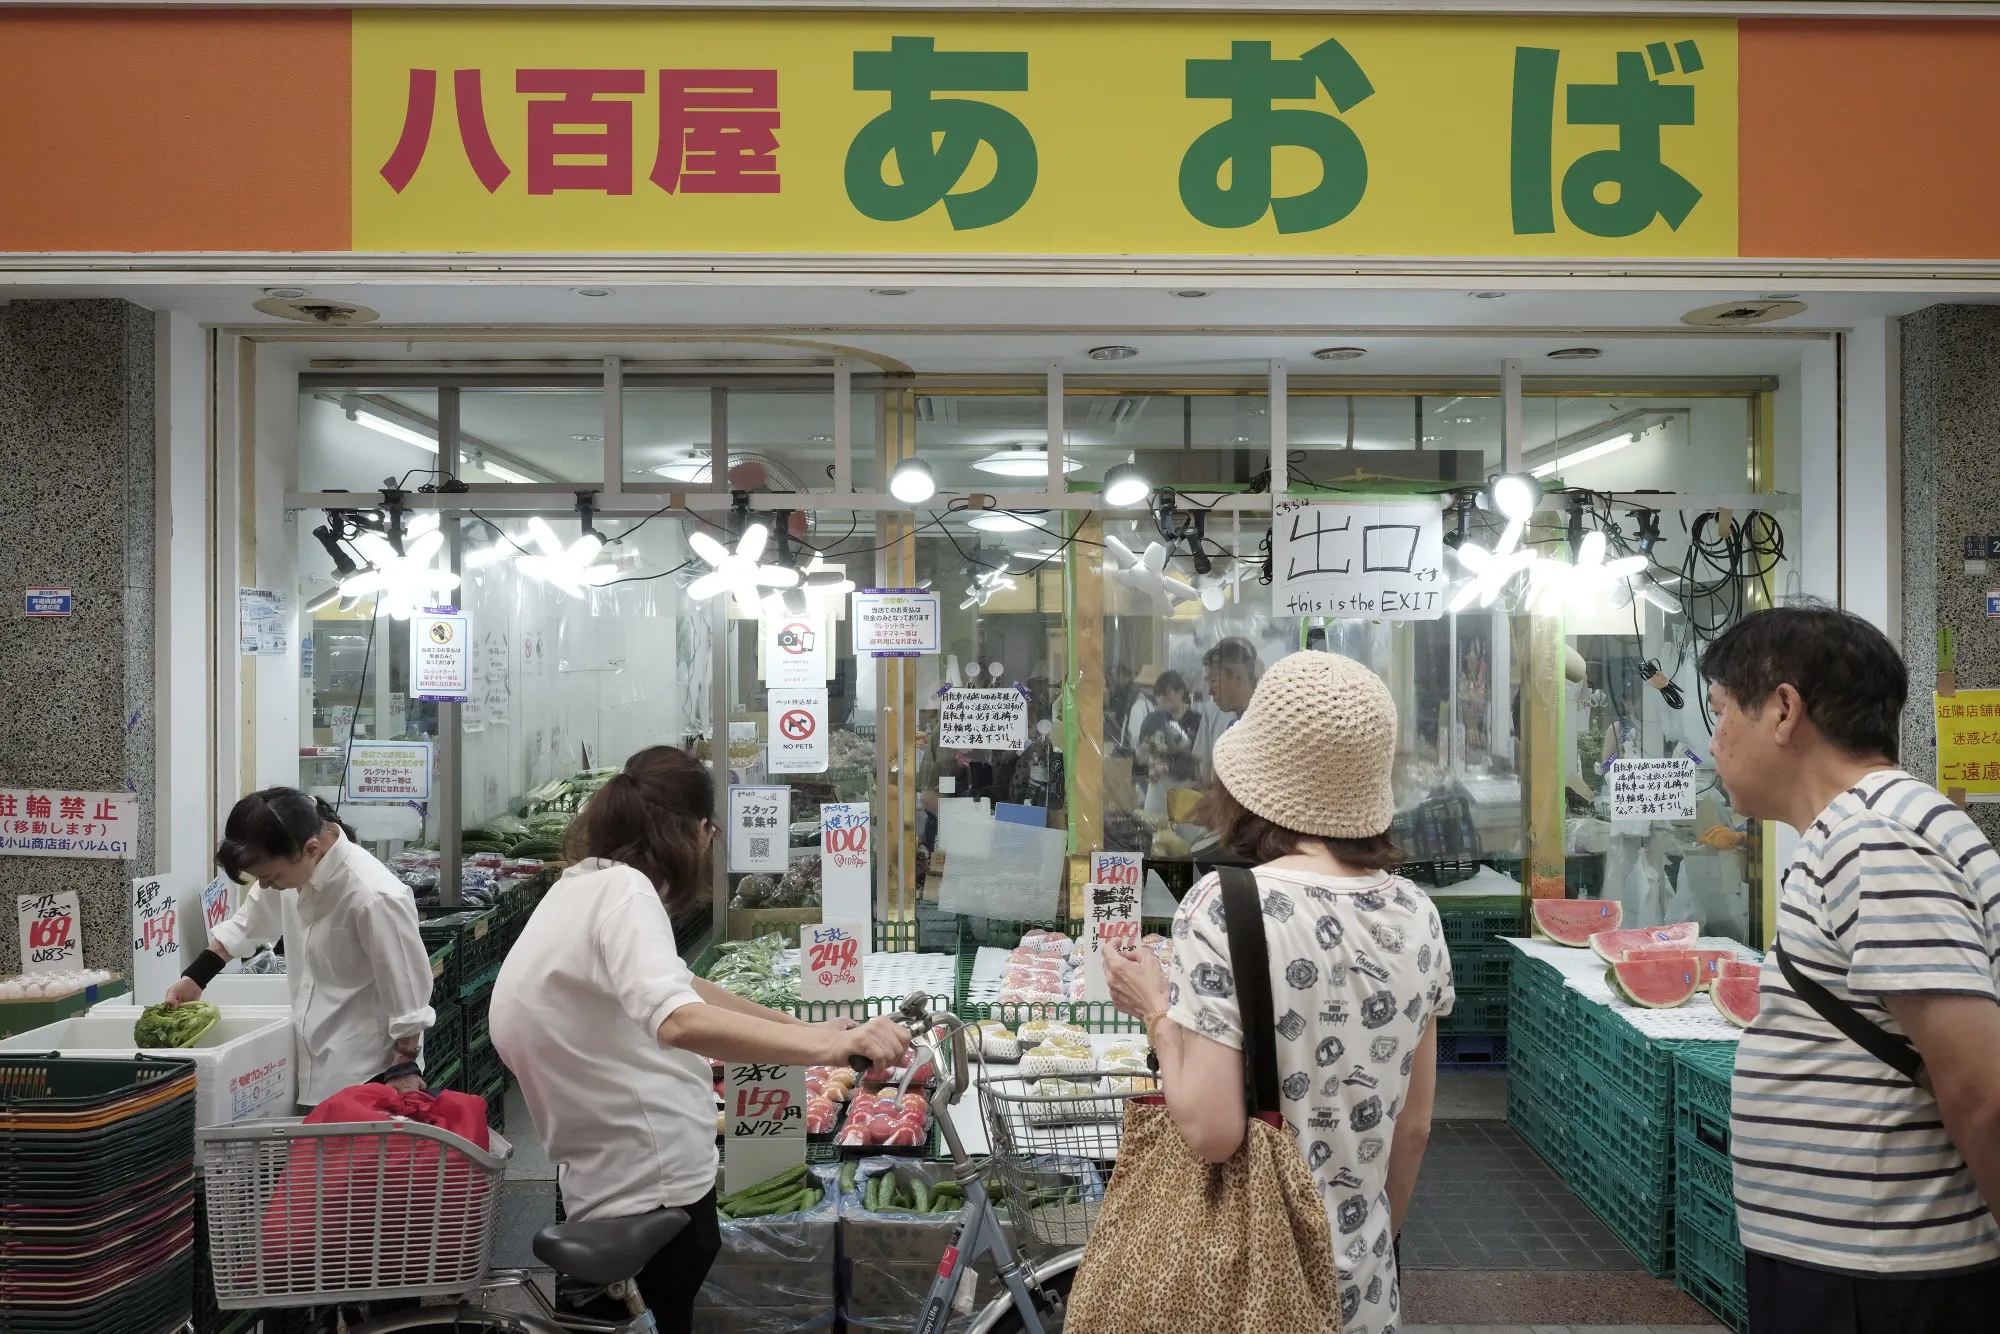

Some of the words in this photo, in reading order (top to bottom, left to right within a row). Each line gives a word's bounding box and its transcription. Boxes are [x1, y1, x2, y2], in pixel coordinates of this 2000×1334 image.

[379, 69, 781, 195] 八百屋
[844, 36, 1704, 237] あおば
[1275, 498, 1311, 516] こちらは
[1287, 510, 1421, 581] 出口
[1967, 549, 1985, 557] 3丁目
[1414, 568, 1439, 582] です
[1287, 591, 1322, 614] this
[1330, 593, 1346, 611] is
[1350, 592, 1374, 611] the
[1381, 590, 1439, 612] EXIT
[1009, 739, 1023, 749] 店主
[363, 768, 412, 776] クレジットカード・
[359, 785, 418, 793] 御利用になれません
[0, 794, 118, 820] 駐輪禁止
[742, 805, 778, 815] スタッフ
[1681, 806, 1694, 816] 店主
[742, 816, 777, 828] 募集中
[134, 881, 161, 909] 長野
[21, 894, 56, 912] ミックス
[140, 896, 177, 919] ブロッコリー
[37, 904, 71, 918] たまご
[814, 928, 851, 943] とまと
[1355, 950, 1390, 979] Tommy
[1319, 1012, 1349, 1022] TOMMY
[1348, 1065, 1379, 1086] Tommy
[1307, 1118, 1340, 1128] TOMMY
[928, 1305, 939, 1321] Life
